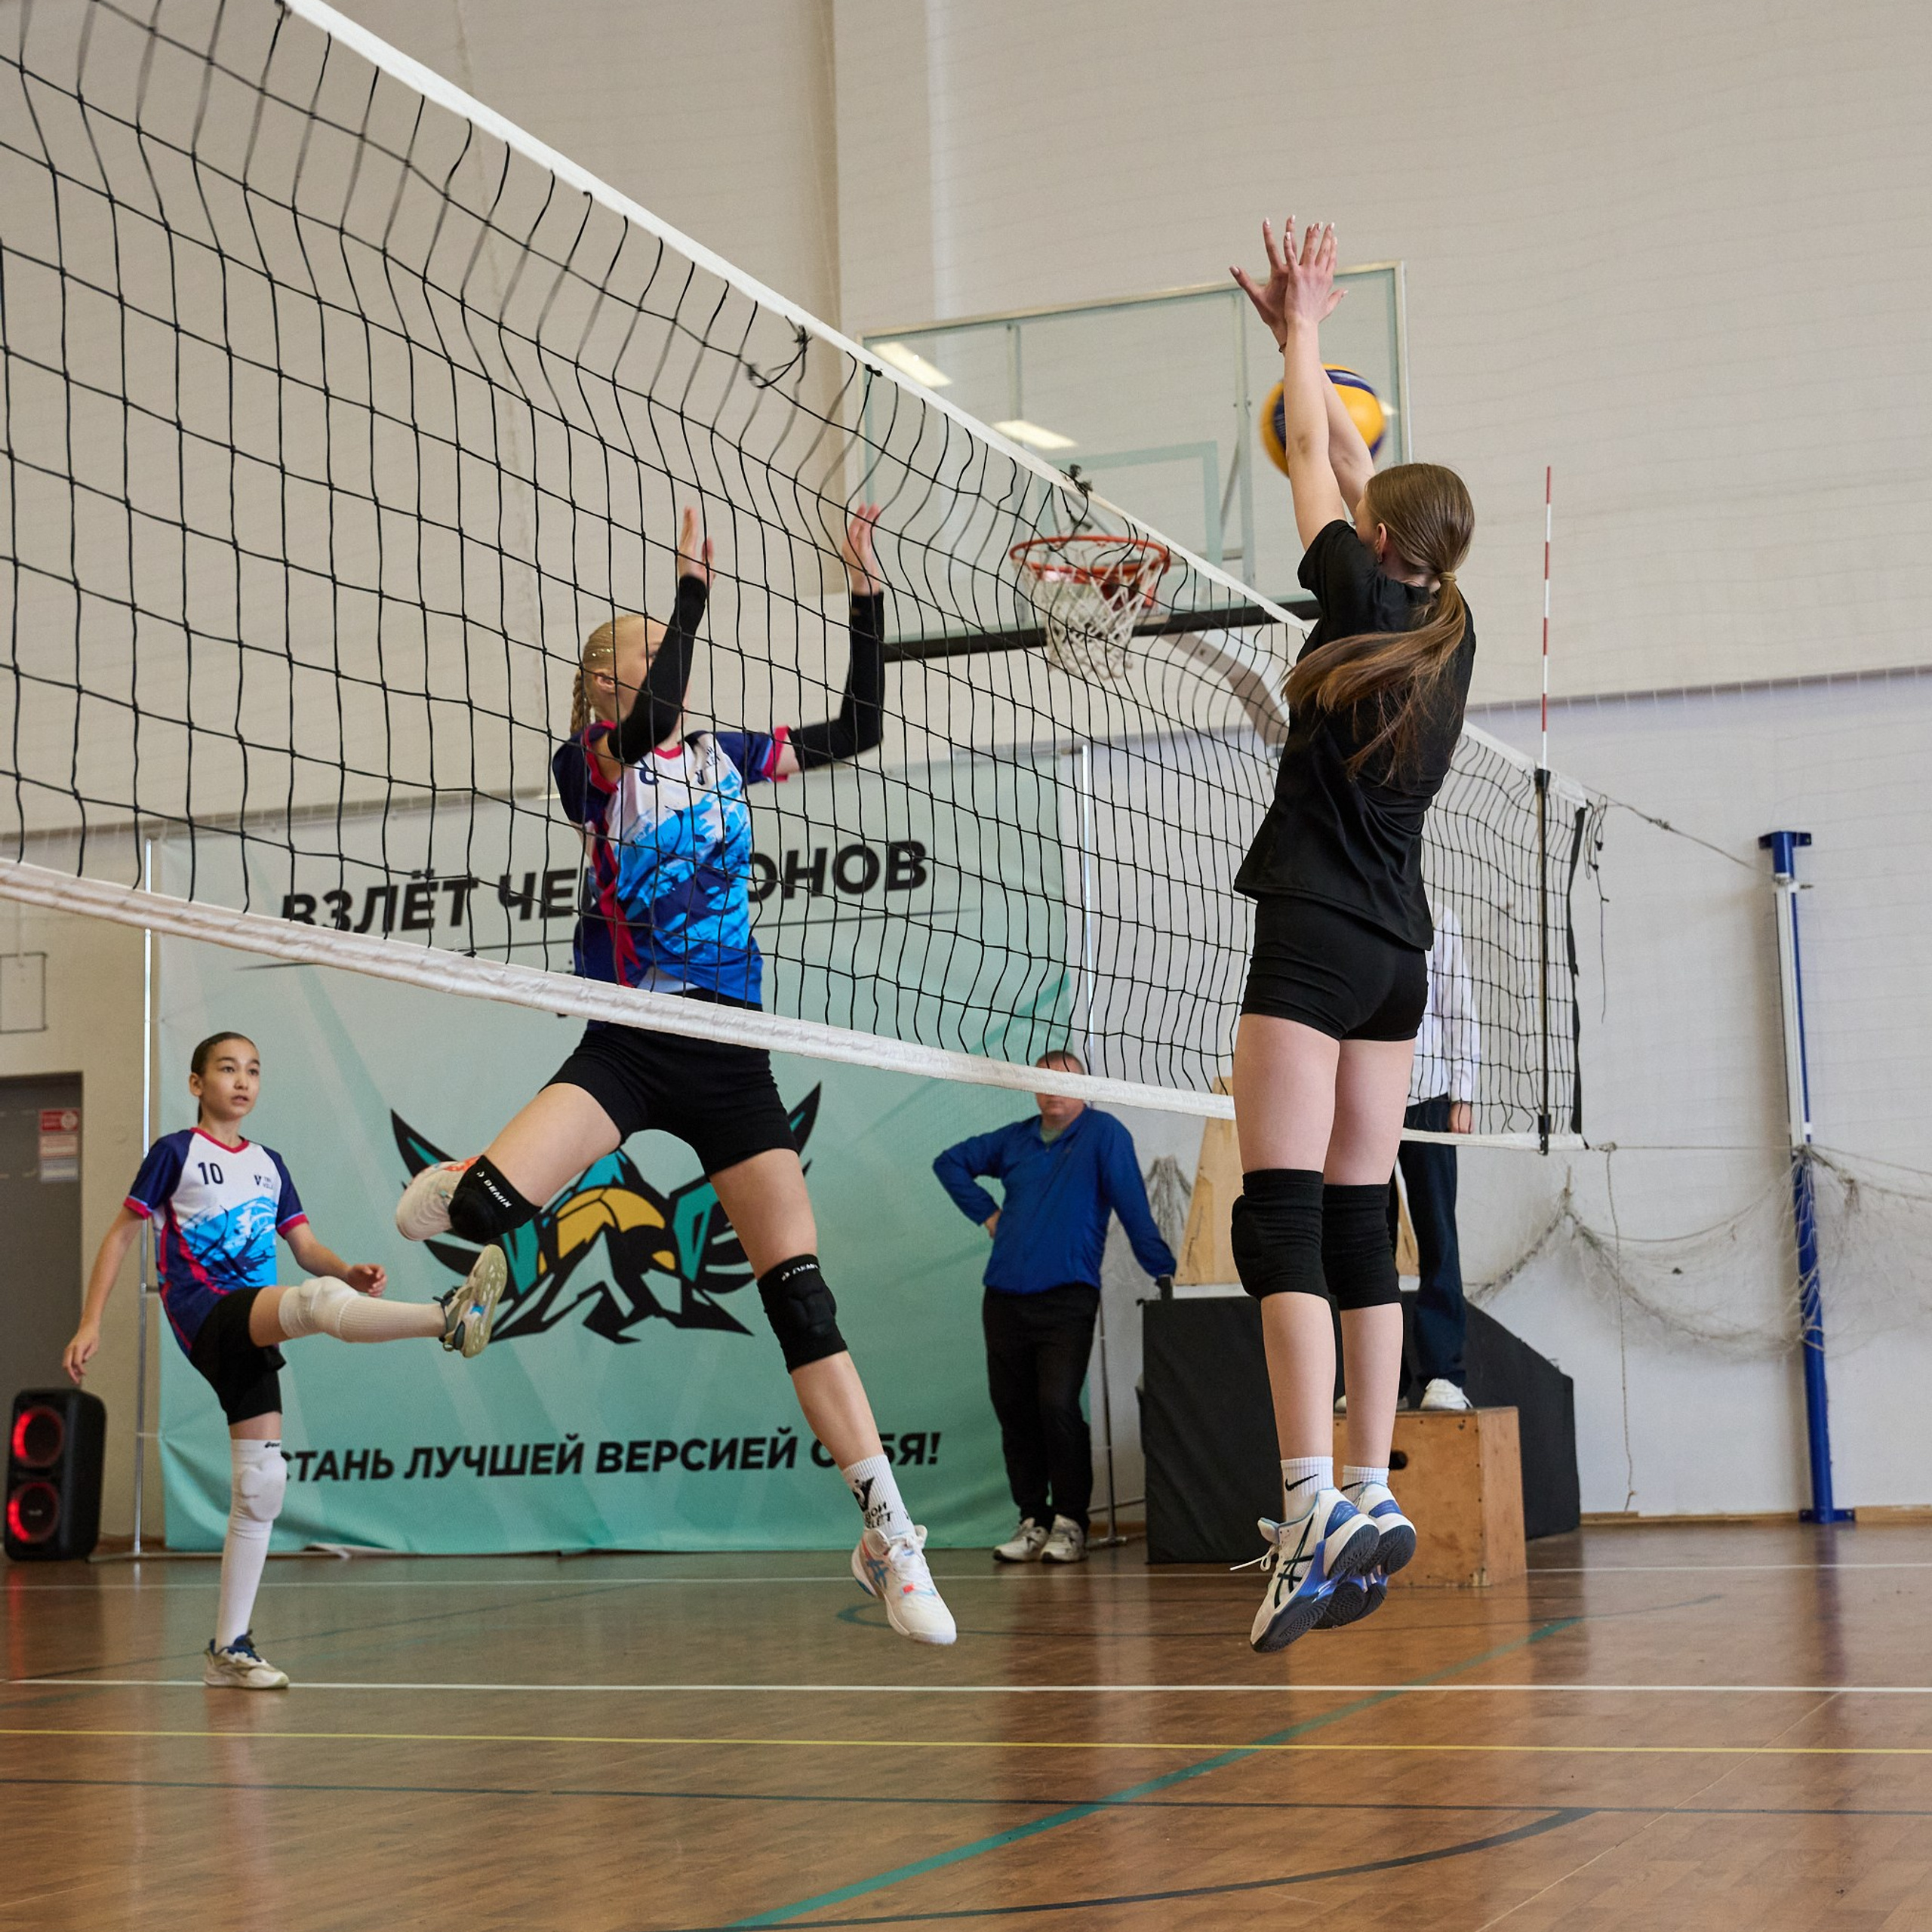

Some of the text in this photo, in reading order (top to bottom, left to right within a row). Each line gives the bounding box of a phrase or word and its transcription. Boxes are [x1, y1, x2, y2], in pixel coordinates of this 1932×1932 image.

[498, 840, 928, 921] ЧЕОНОВ
[198, 1161, 224, 1185] 10
[483, 1179, 512, 1208] DEMIX
[281, 1426, 942, 1482] ТАНЬ ЛУЧШЕЙ ВЕРСИЕЙ СЯ!
